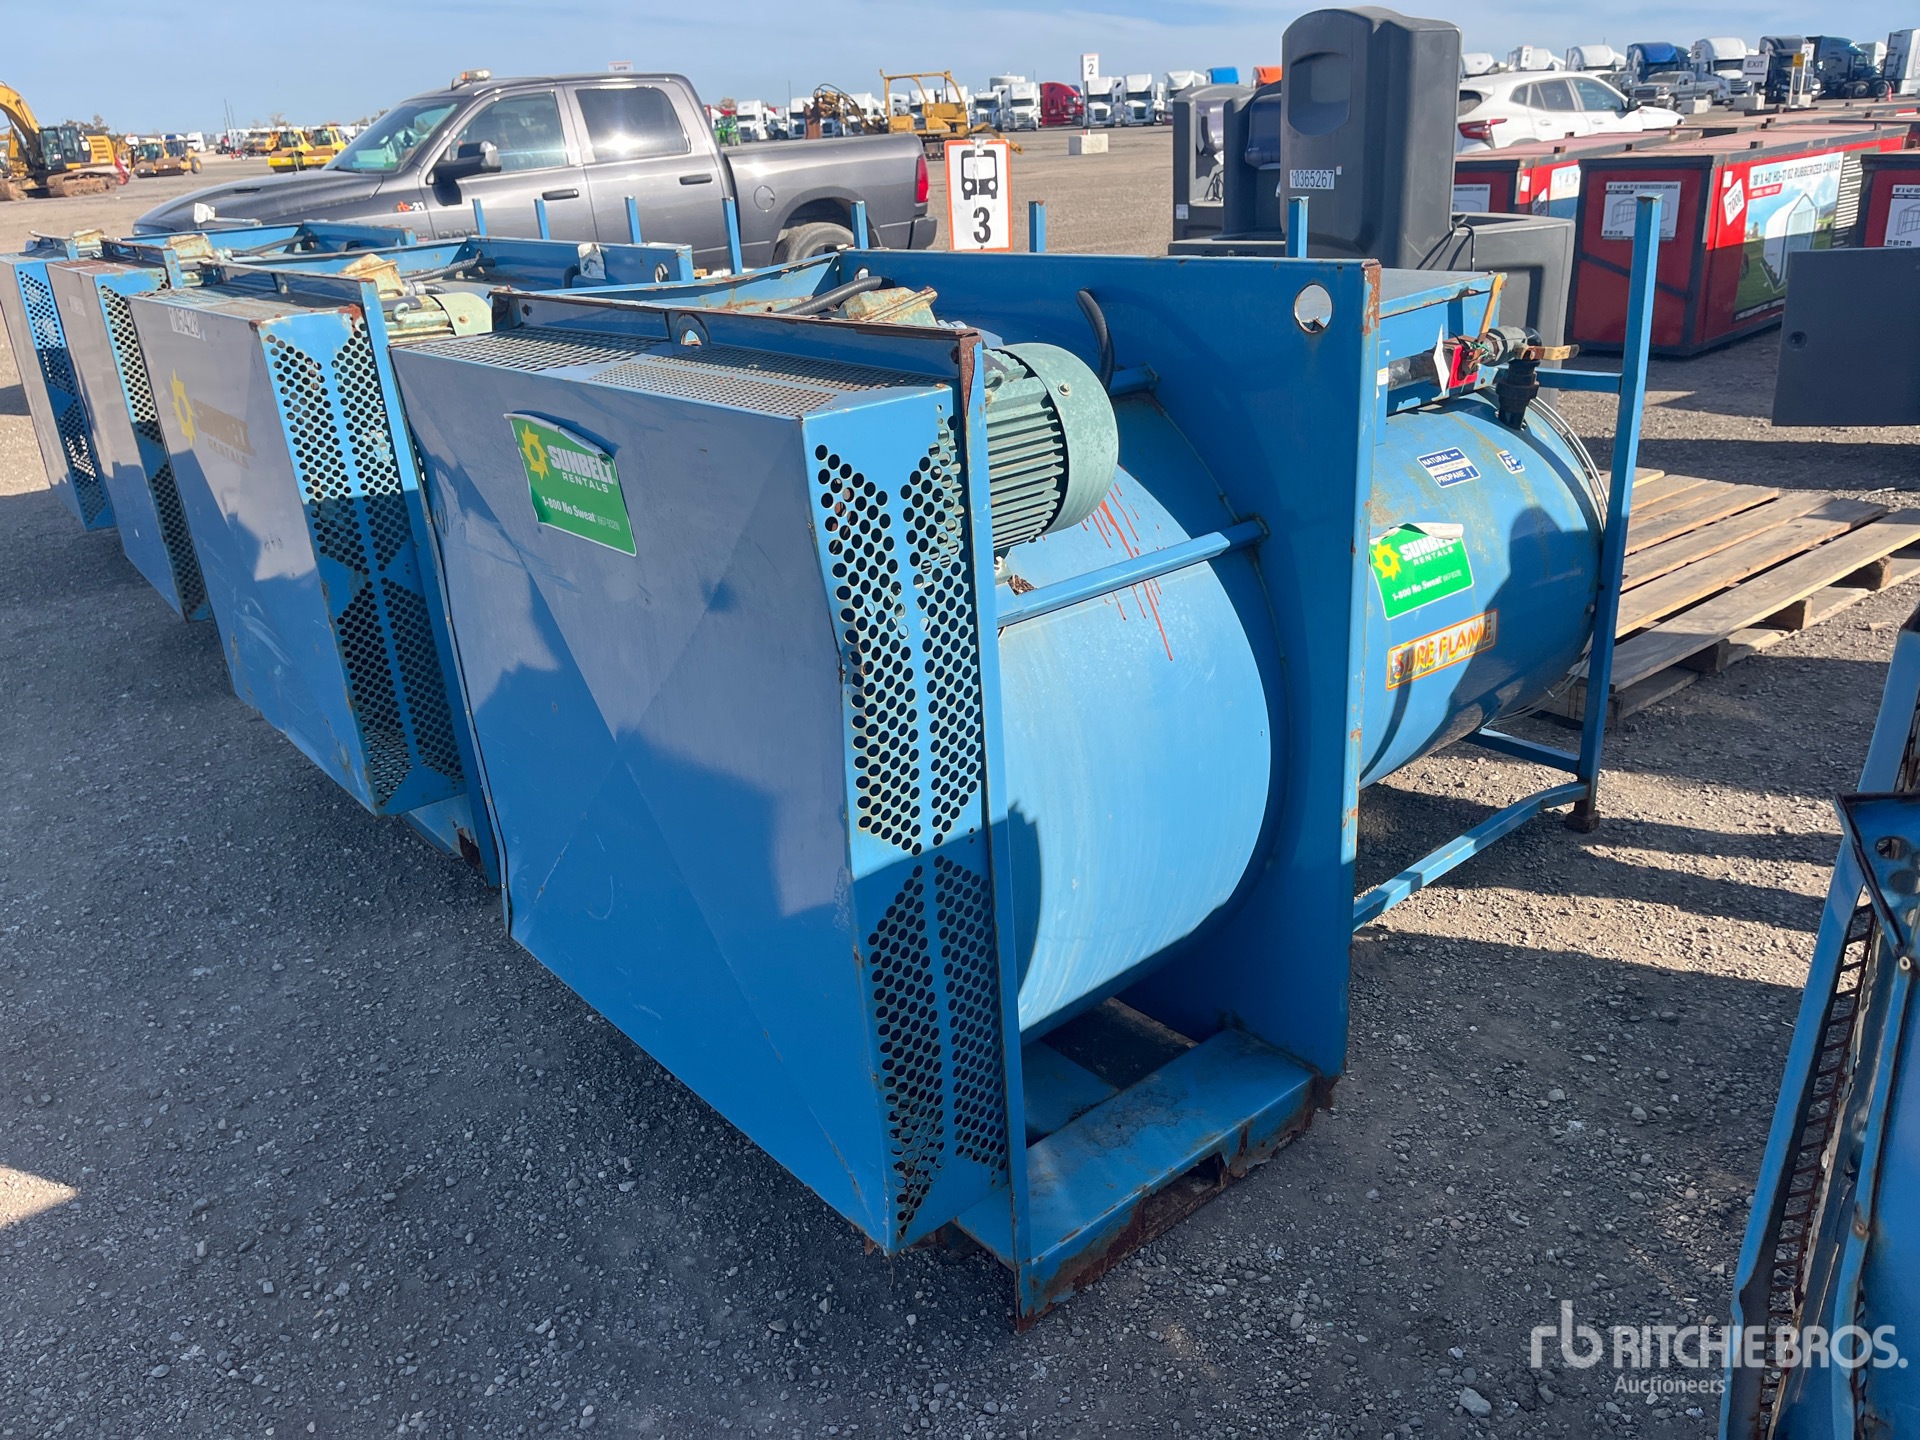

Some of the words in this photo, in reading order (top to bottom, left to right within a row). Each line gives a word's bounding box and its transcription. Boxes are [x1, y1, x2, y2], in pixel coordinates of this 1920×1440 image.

[1088, 63, 1095, 75] 2
[1747, 60, 1764, 69] EXIT
[1291, 170, 1334, 188] 10365267
[1794, 163, 1823, 179] RUBBERIZED
[1823, 160, 1841, 173] CANVAS
[973, 206, 992, 244] 3
[546, 445, 614, 485] SUNBELT
[1421, 453, 1452, 466] NATURAL
[551, 472, 609, 494] RENTALS
[1435, 470, 1466, 484] PROPANE
[542, 496, 562, 511] 1-800
[562, 501, 573, 515] No
[573, 505, 597, 523] Sweat
[1412, 545, 1454, 566] RENTALS
[1392, 587, 1411, 601] 1-800
[1411, 584, 1421, 594] No
[1422, 576, 1442, 590] Sweat
[1394, 641, 1435, 679] SURE
[1439, 618, 1492, 662] FLAME
